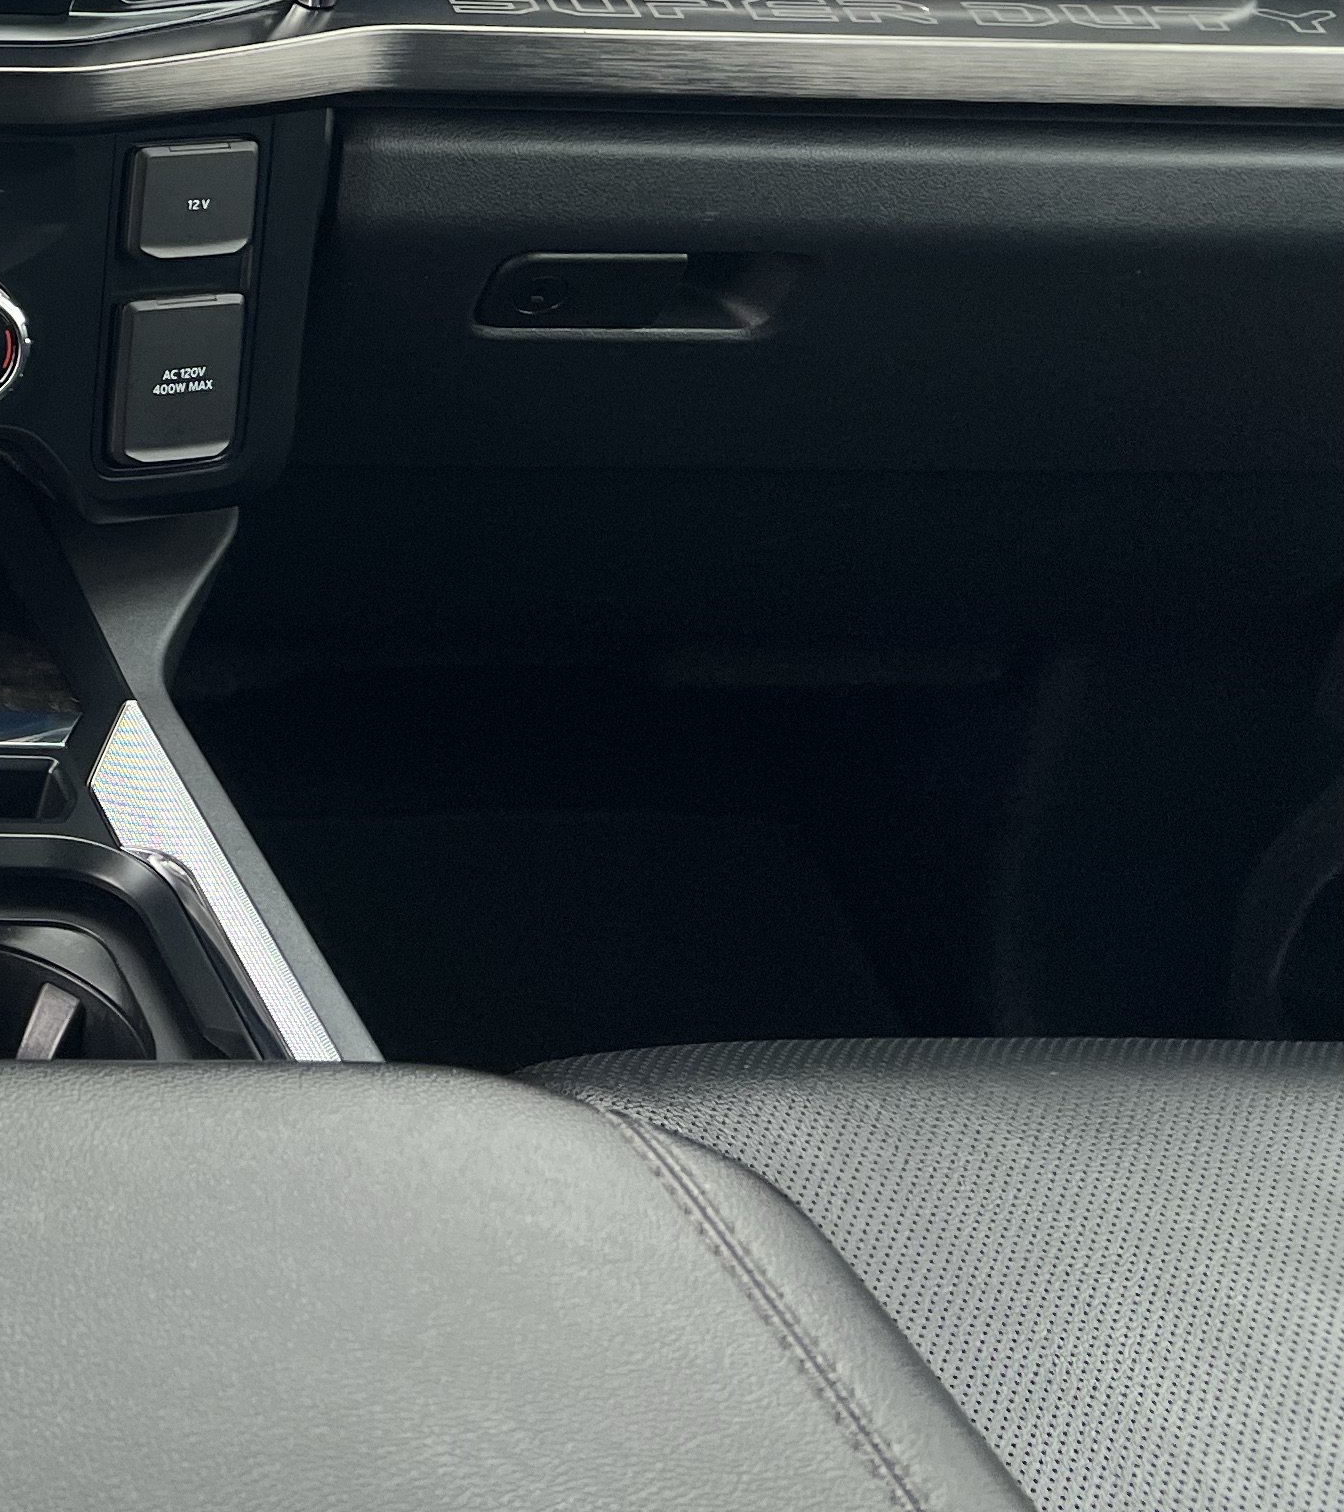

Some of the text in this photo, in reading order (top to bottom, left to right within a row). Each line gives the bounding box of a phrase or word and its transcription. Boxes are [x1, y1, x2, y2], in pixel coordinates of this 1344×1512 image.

[959, 0, 1337, 34] DUTY
[187, 199, 210, 210] 12 V
[162, 366, 206, 381] AC 120V
[153, 379, 213, 396] 400W MAX
